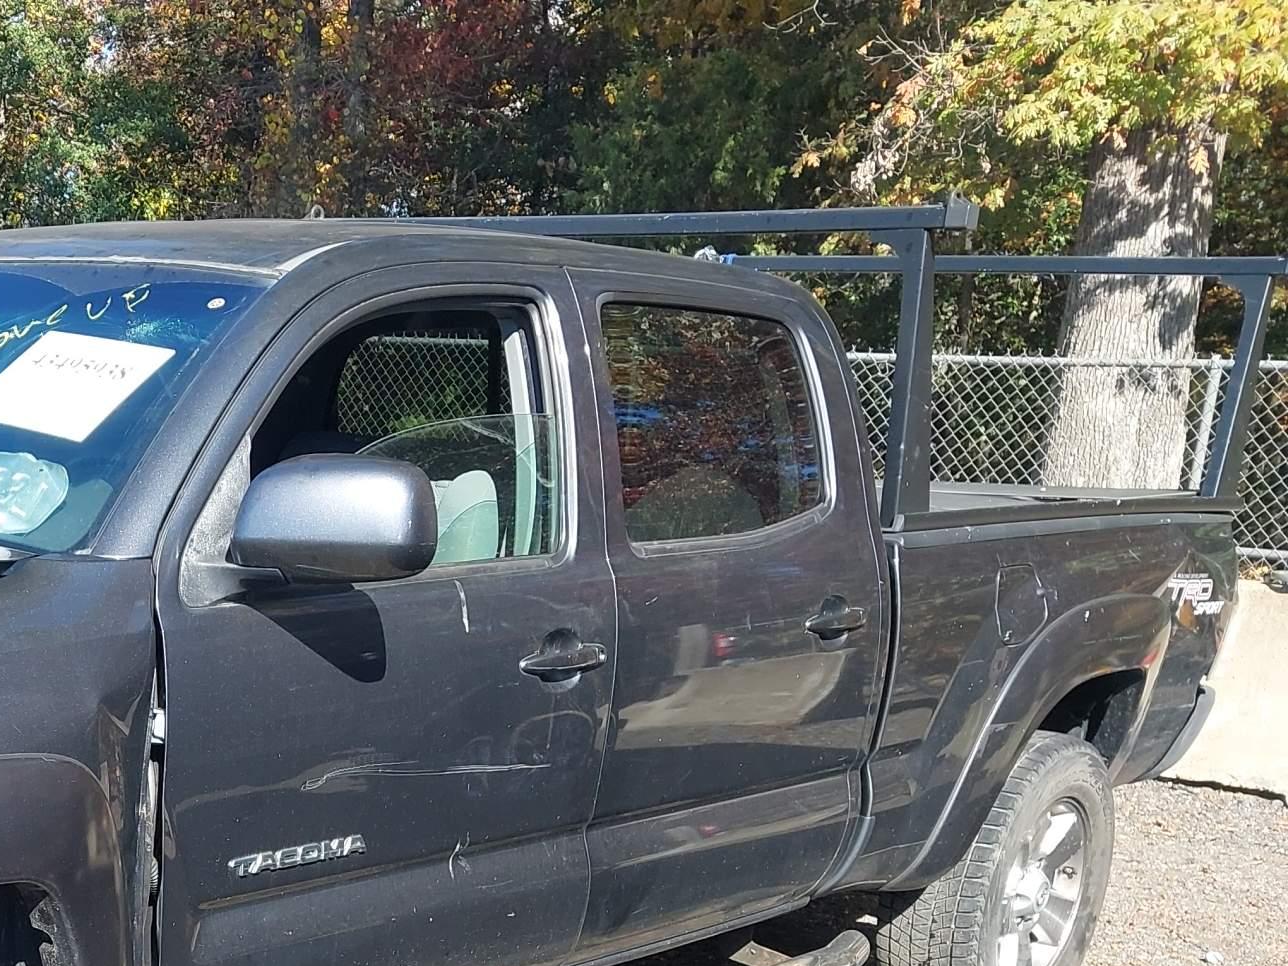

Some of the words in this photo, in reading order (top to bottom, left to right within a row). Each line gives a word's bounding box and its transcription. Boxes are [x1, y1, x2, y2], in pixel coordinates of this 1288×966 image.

[1168, 578, 1214, 608] TRD
[1193, 600, 1225, 616] SPORT
[227, 834, 368, 877] TACOMA
